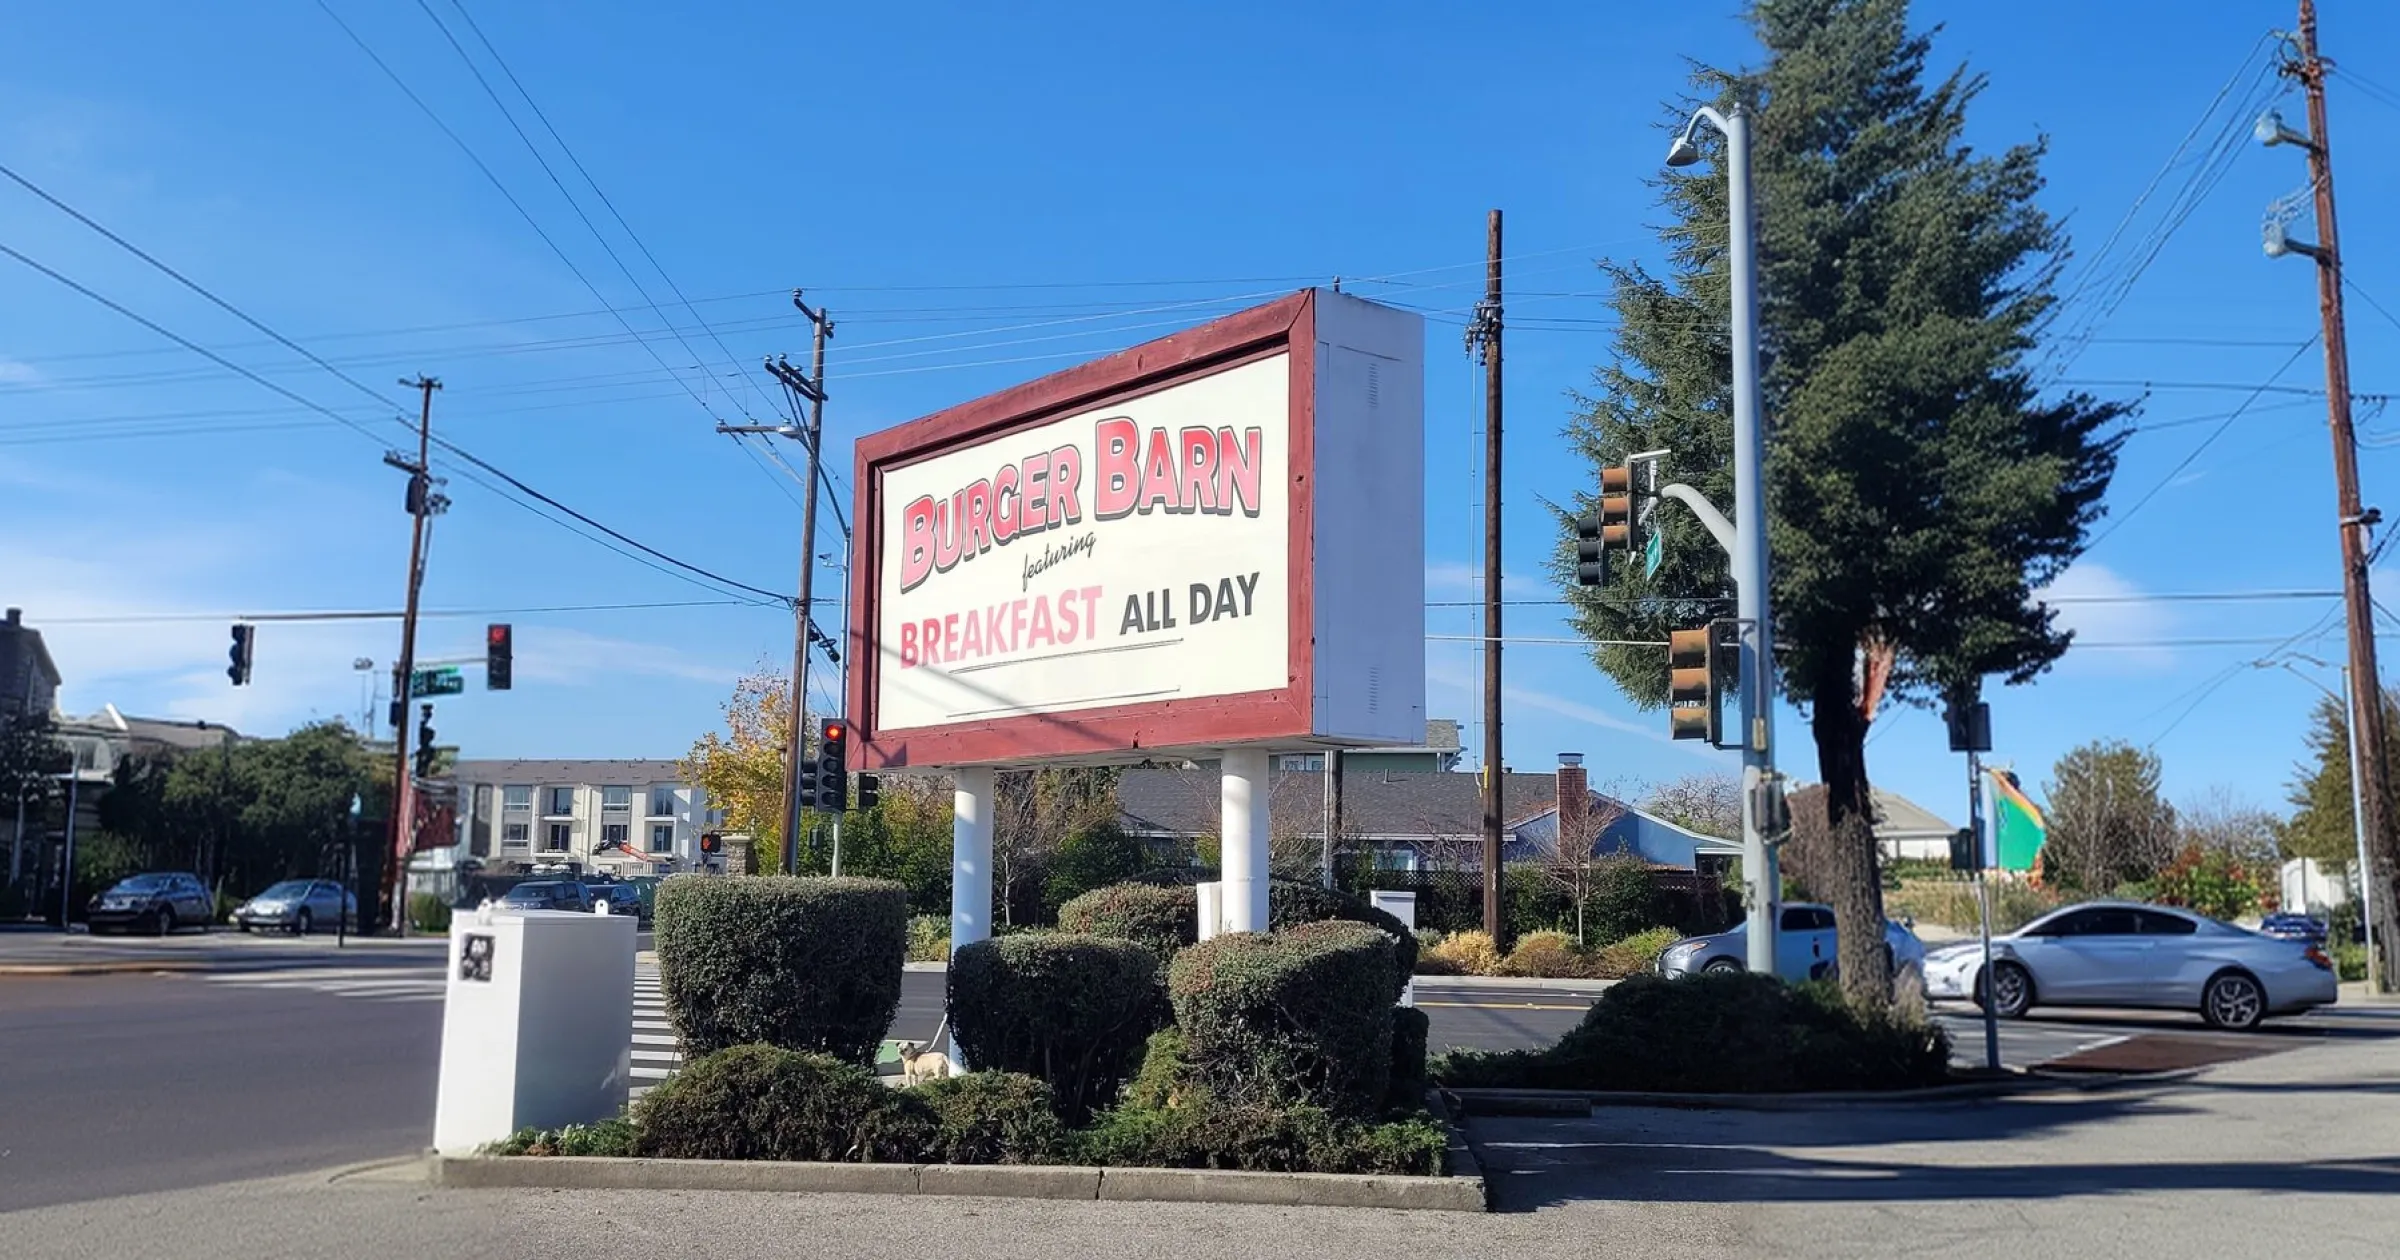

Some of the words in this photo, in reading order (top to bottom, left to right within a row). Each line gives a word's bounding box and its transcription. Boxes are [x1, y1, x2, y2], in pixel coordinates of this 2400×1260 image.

[900, 443, 1082, 595] BURGER
[1095, 416, 1262, 521] BARN
[1022, 531, 1096, 592] featuring
[900, 585, 1103, 670] BREAKFAST
[1119, 588, 1177, 636] ALL
[1189, 571, 1260, 625] DAY
